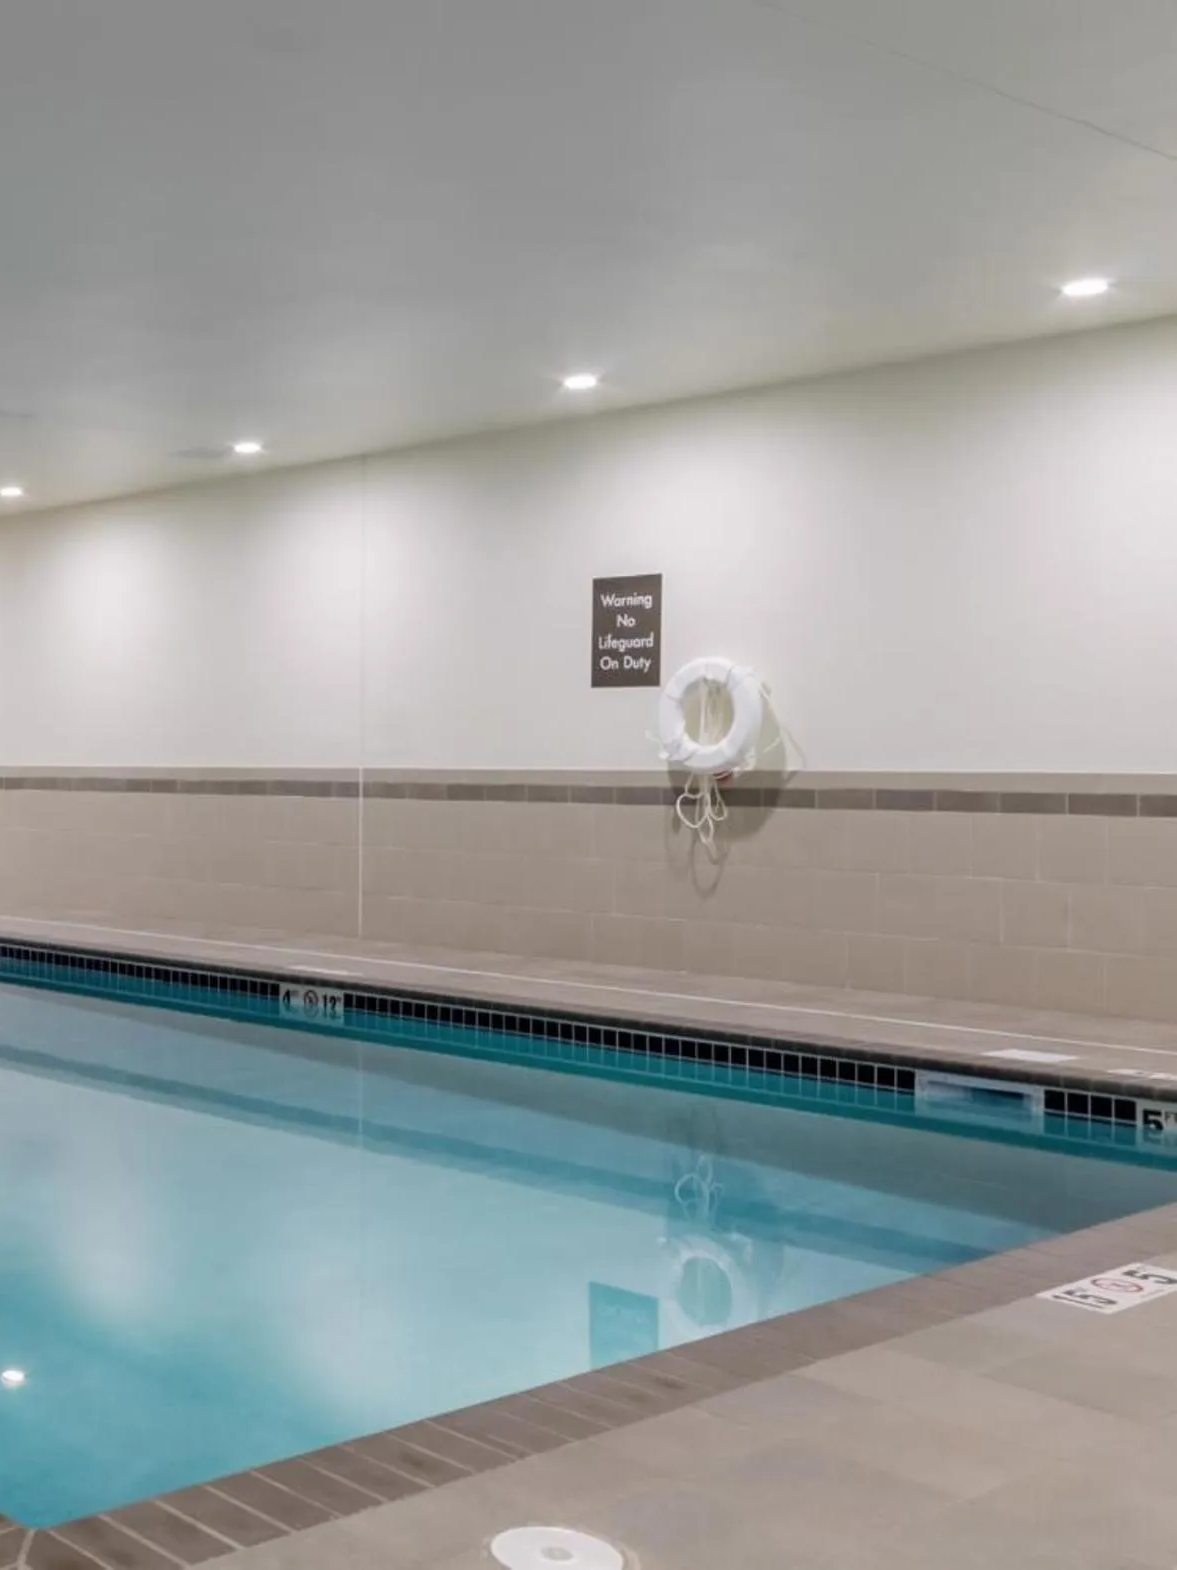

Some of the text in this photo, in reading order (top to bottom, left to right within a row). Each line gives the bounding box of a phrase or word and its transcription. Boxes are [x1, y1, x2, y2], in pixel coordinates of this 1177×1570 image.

[600, 592, 652, 609] Warning
[617, 613, 636, 628] No
[598, 631, 655, 652] Lifeguard
[600, 655, 652, 673] On Duty
[1143, 1108, 1164, 1131] 5
